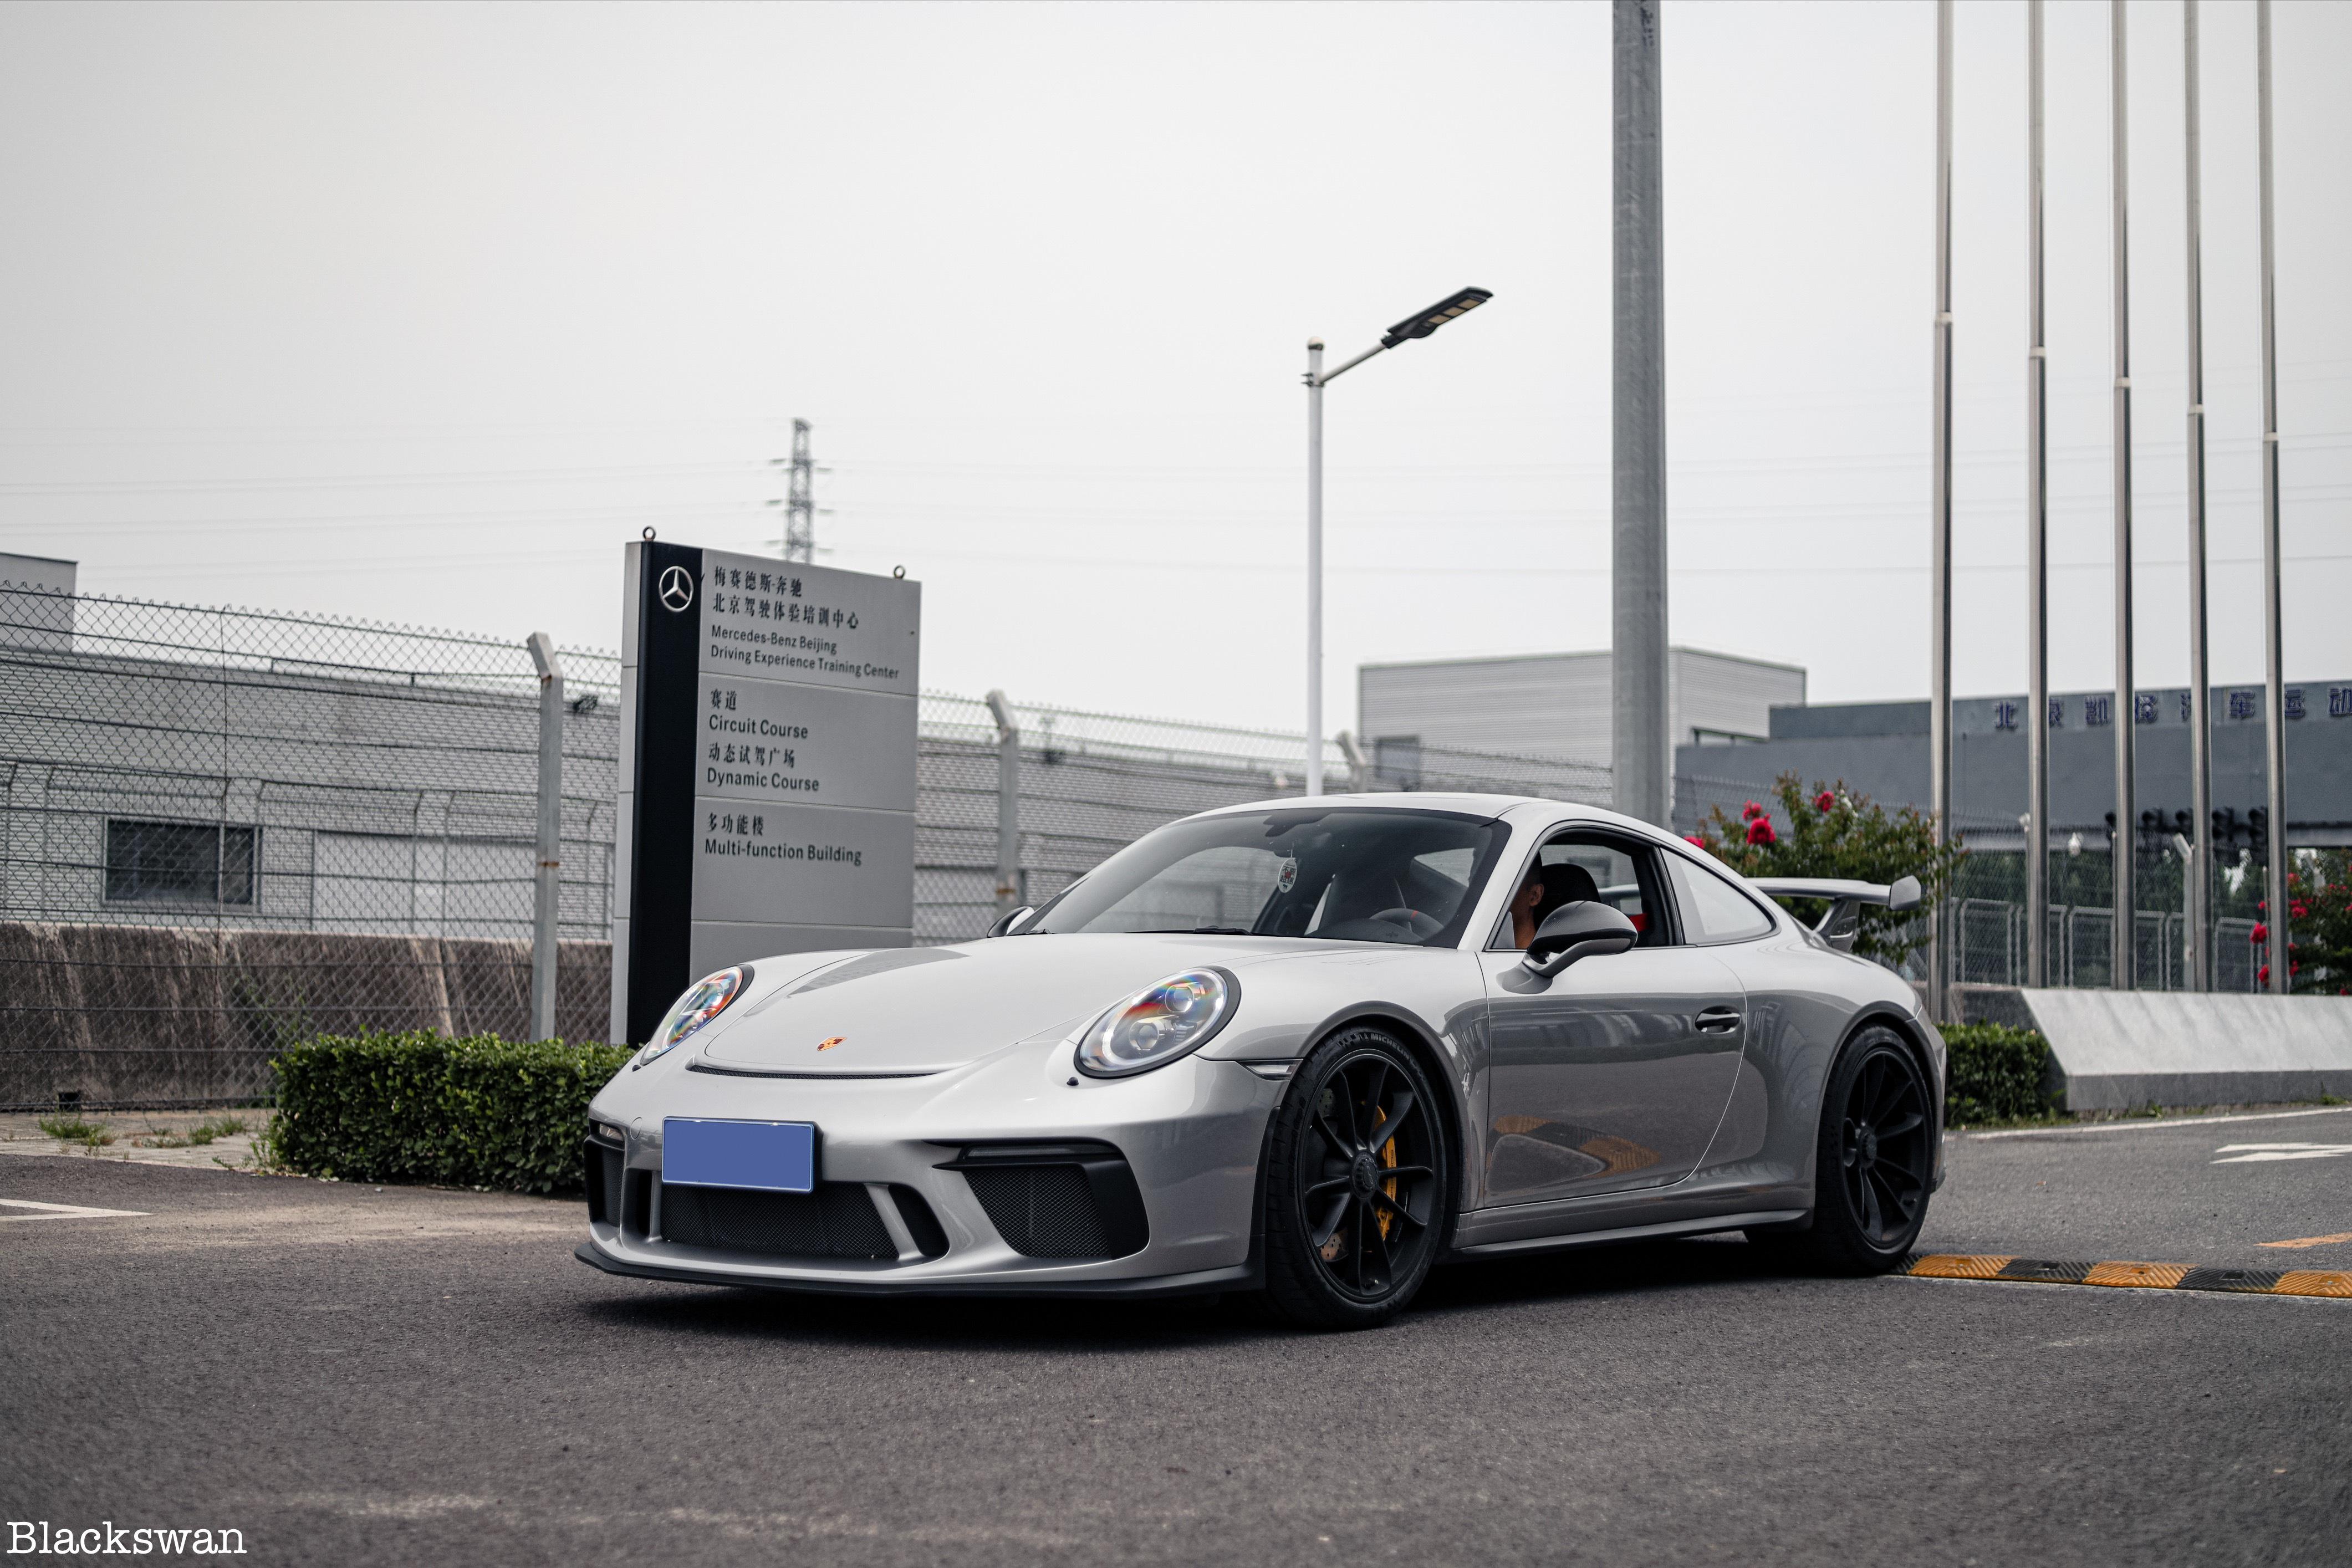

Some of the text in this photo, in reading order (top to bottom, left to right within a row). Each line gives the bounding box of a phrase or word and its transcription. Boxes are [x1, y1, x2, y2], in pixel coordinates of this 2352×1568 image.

[713, 593, 859, 629] 北京驾驶体验培训中心
[712, 625, 837, 655] Mercedes-Benz Beijing
[711, 645, 899, 679] Driving Experience Training Center
[711, 689, 737, 711] 赛道
[710, 714, 808, 739] Circuit Course
[709, 742, 794, 768] 动态试驾广场
[707, 768, 819, 791] Dynamic Course
[709, 812, 763, 836] 多功能楼
[705, 839, 861, 866] Multi-function Building
[1370, 1033, 1410, 1060] MICHELIN
